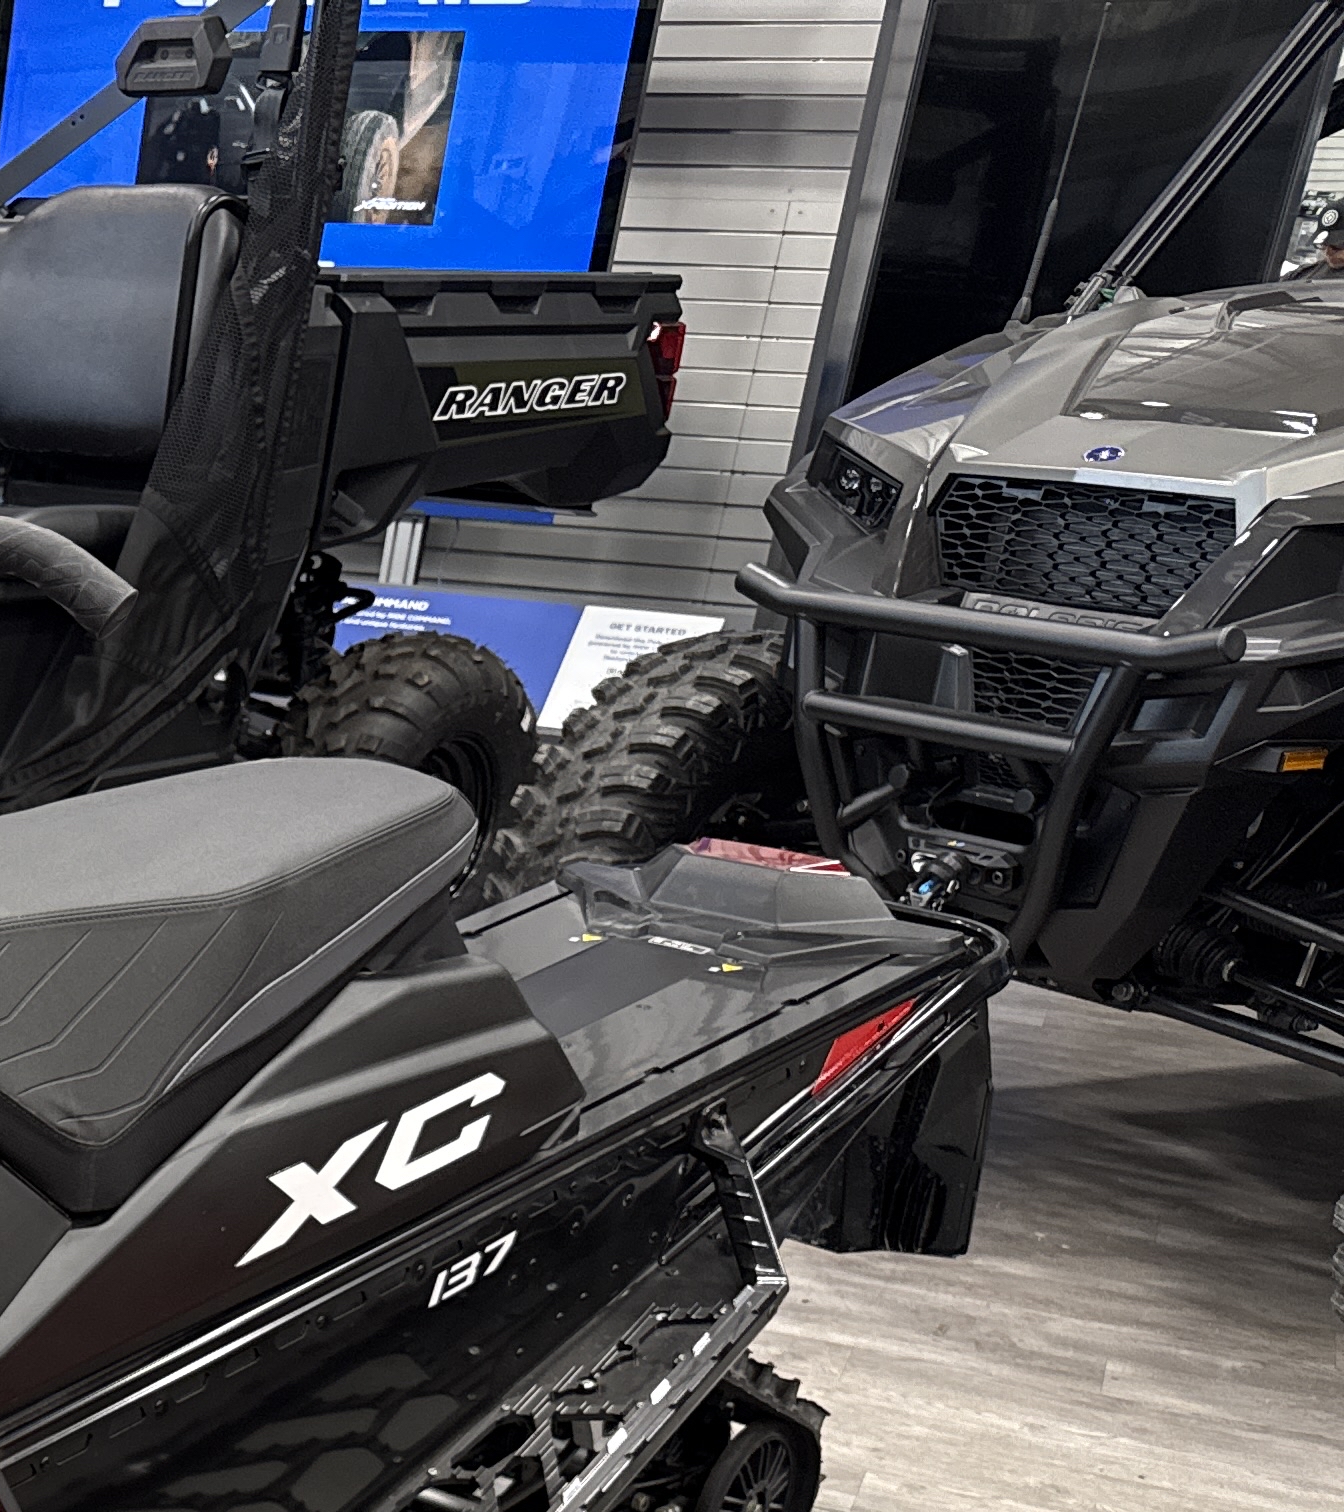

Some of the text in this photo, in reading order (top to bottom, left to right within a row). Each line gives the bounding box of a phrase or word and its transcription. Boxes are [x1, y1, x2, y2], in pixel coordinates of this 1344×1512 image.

[432, 372, 626, 421] RANGER
[609, 622, 687, 636] GET STARTED
[234, 1072, 507, 1268] XC
[427, 1229, 518, 1309] 137
